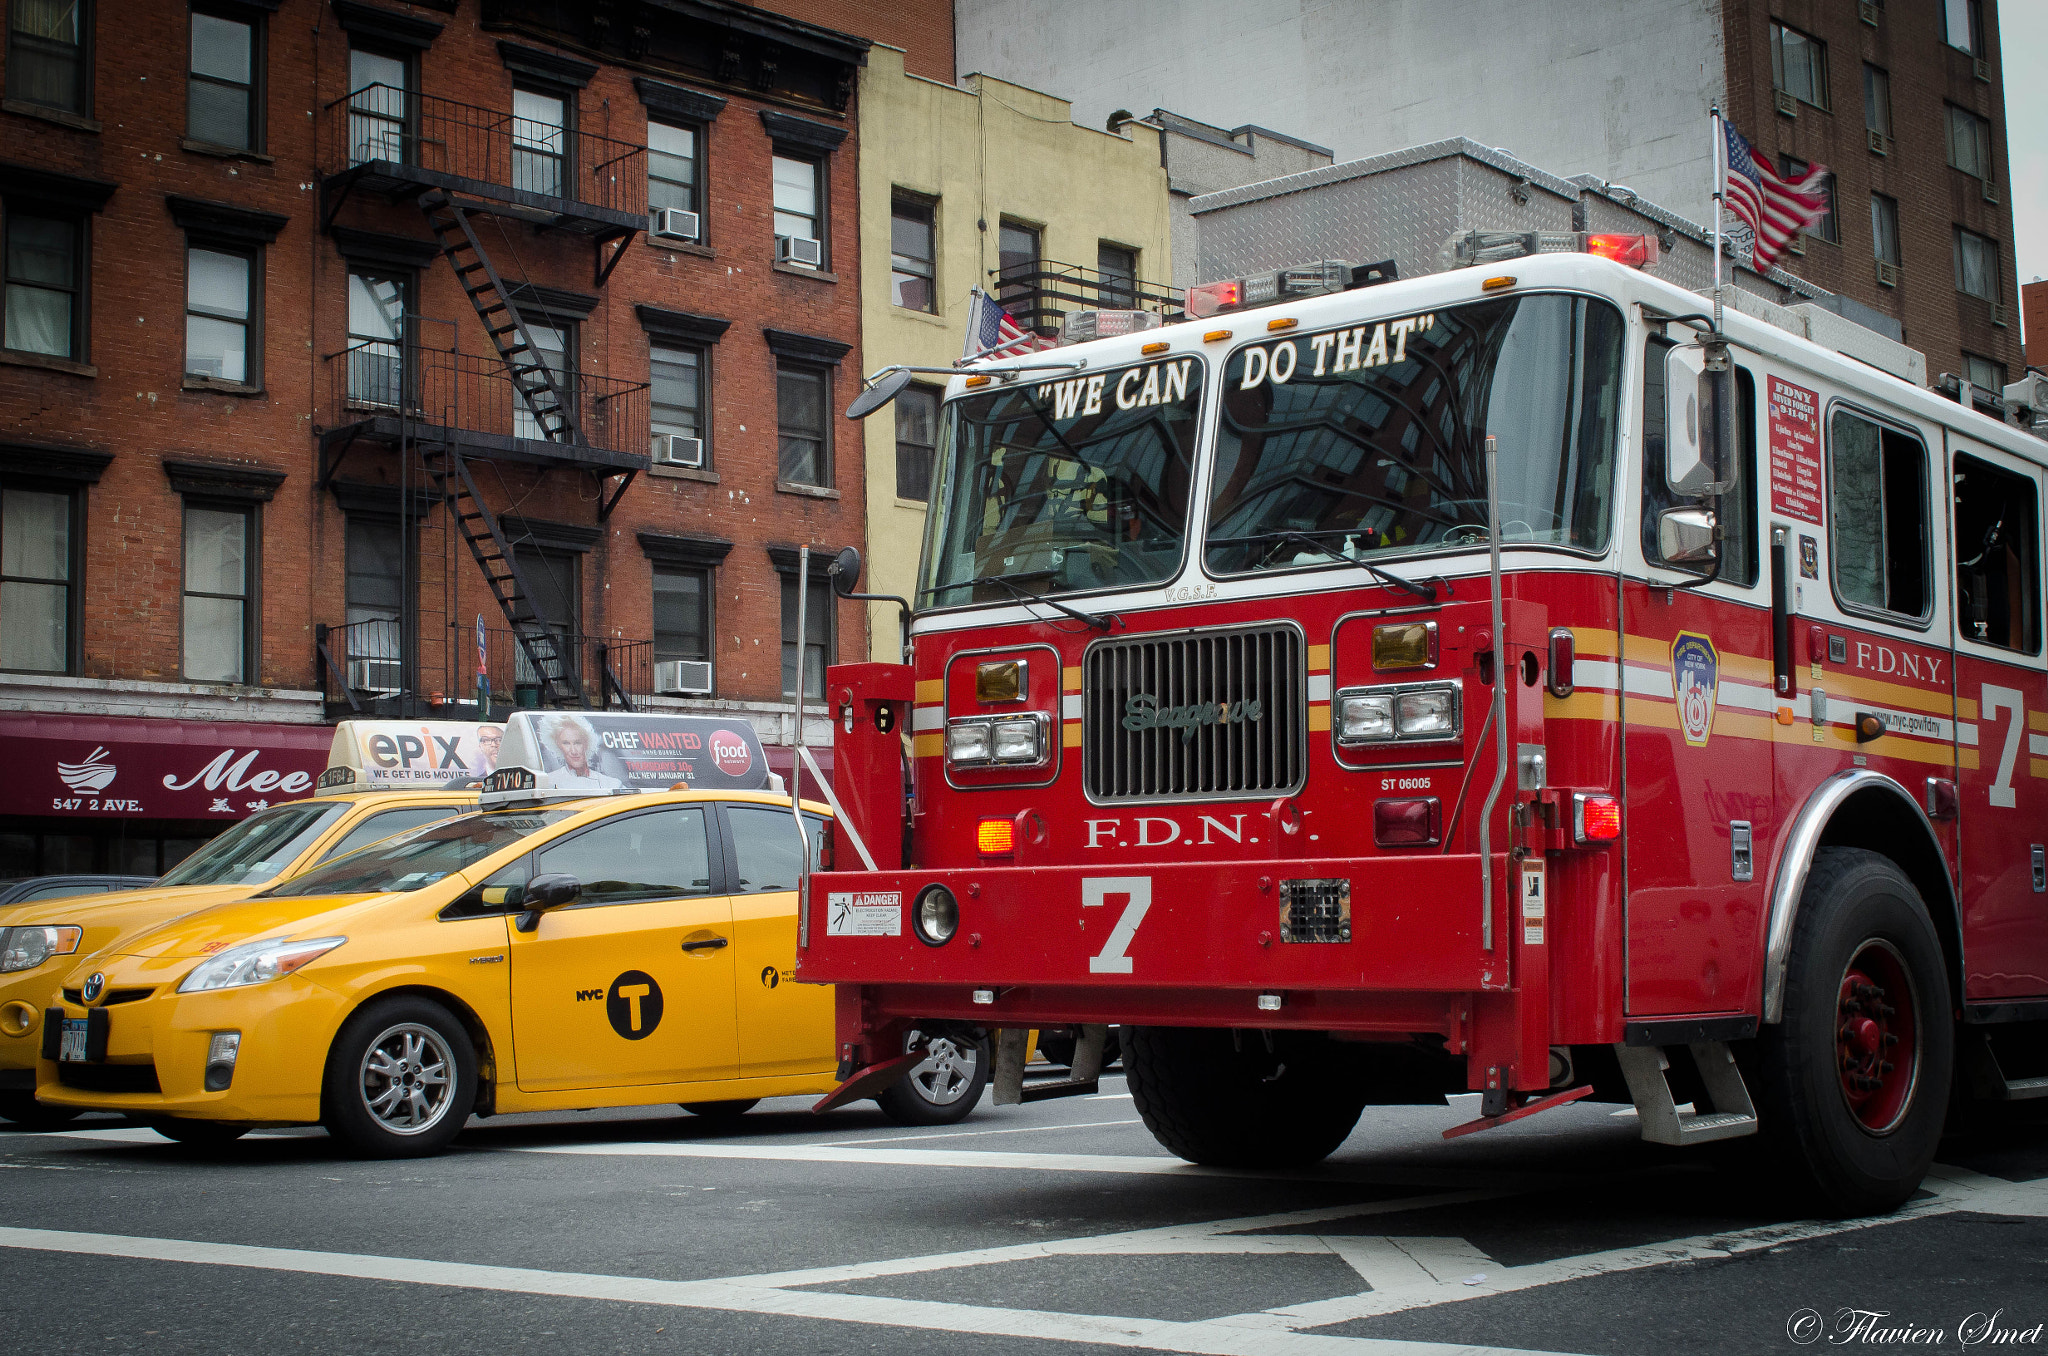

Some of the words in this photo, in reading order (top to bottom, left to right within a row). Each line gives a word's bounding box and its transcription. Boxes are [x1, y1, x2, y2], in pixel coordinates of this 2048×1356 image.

[1115, 358, 1192, 411] CAN
[1240, 340, 1298, 391] DO
[1774, 381, 1811, 403] FDNY
[1773, 392, 1792, 407] NEVER
[1792, 399, 1815, 415] FORGET
[1780, 404, 1808, 422] 9-11-01
[1163, 584, 1218, 603] V.G.S.F.
[1855, 641, 1946, 684] F.D.N.Y.
[602, 731, 639, 749] CHEF
[638, 732, 702, 750] WANTED
[1981, 682, 2024, 809] 7
[713, 740, 748, 766] food
[163, 748, 313, 793] Mee
[373, 769, 389, 779] WE
[391, 770, 411, 780] GET
[414, 770, 432, 780] BIG
[625, 761, 676, 772] THURSDAYS
[628, 771, 639, 779] ALL
[641, 772, 657, 780] NEW
[658, 772, 686, 780] JANUARY
[686, 772, 696, 780] 31
[497, 771, 522, 790] 7V10
[1381, 778, 1396, 791] ST
[1398, 777, 1431, 790] 06005
[52, 798, 82, 811] 547
[89, 799, 99, 811] 2
[103, 799, 144, 812] AVE.
[864, 894, 899, 905] DANGER
[1081, 876, 1153, 974] 7
[576, 988, 604, 1003] NYC
[618, 983, 651, 1032] T
